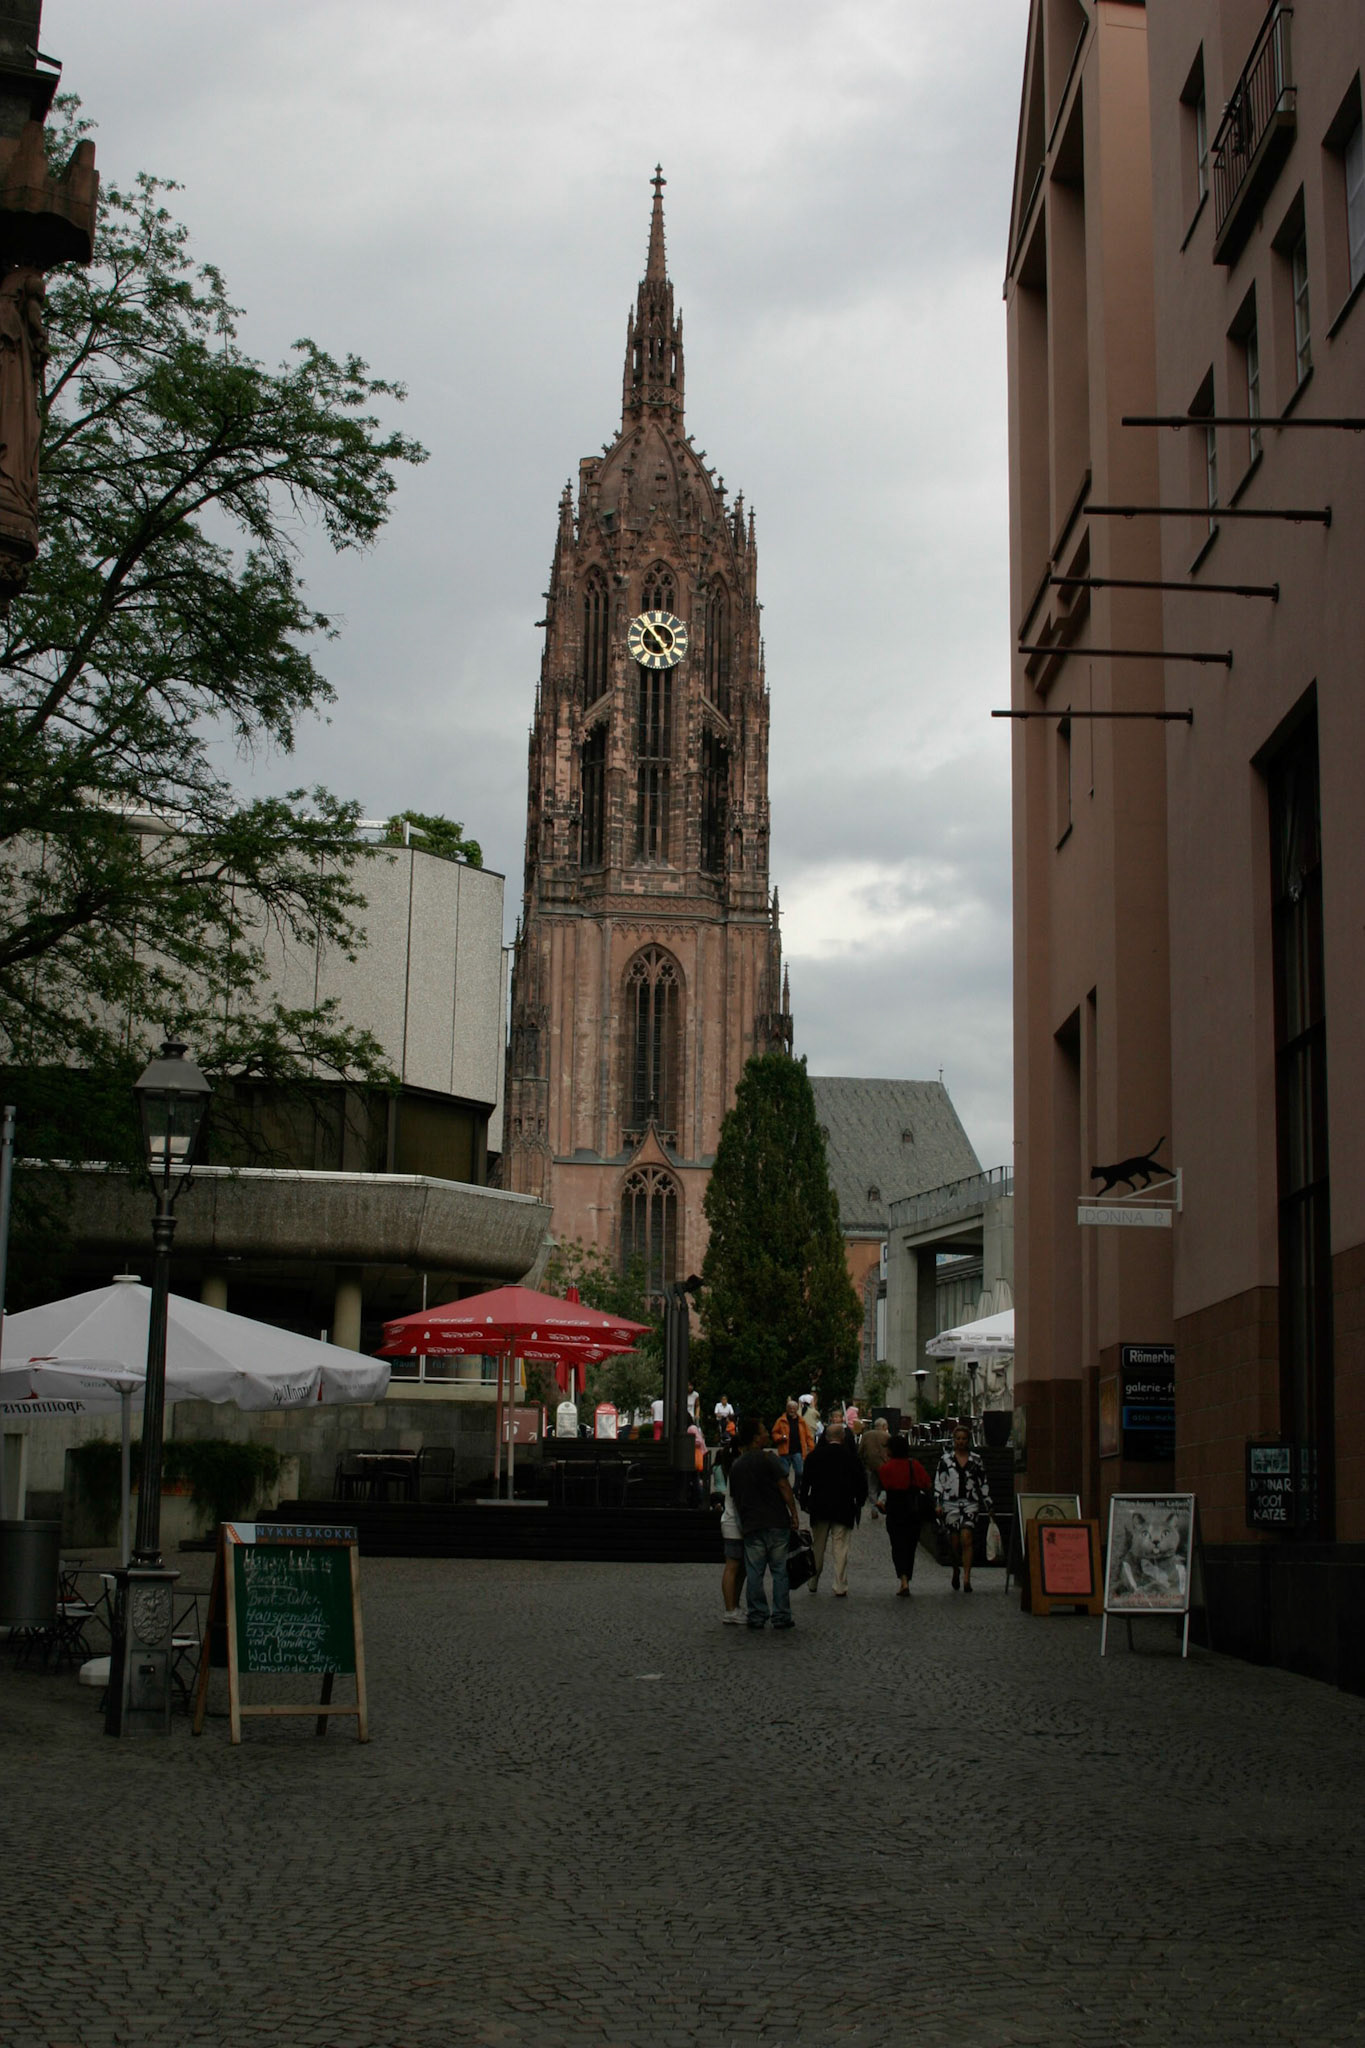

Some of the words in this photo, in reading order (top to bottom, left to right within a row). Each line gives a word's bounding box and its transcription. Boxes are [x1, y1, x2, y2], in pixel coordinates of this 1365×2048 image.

[1085, 1209, 1144, 1224] DONNA
[272, 1383, 313, 1406] Apollinari
[1253, 1508, 1288, 1521] KATZE
